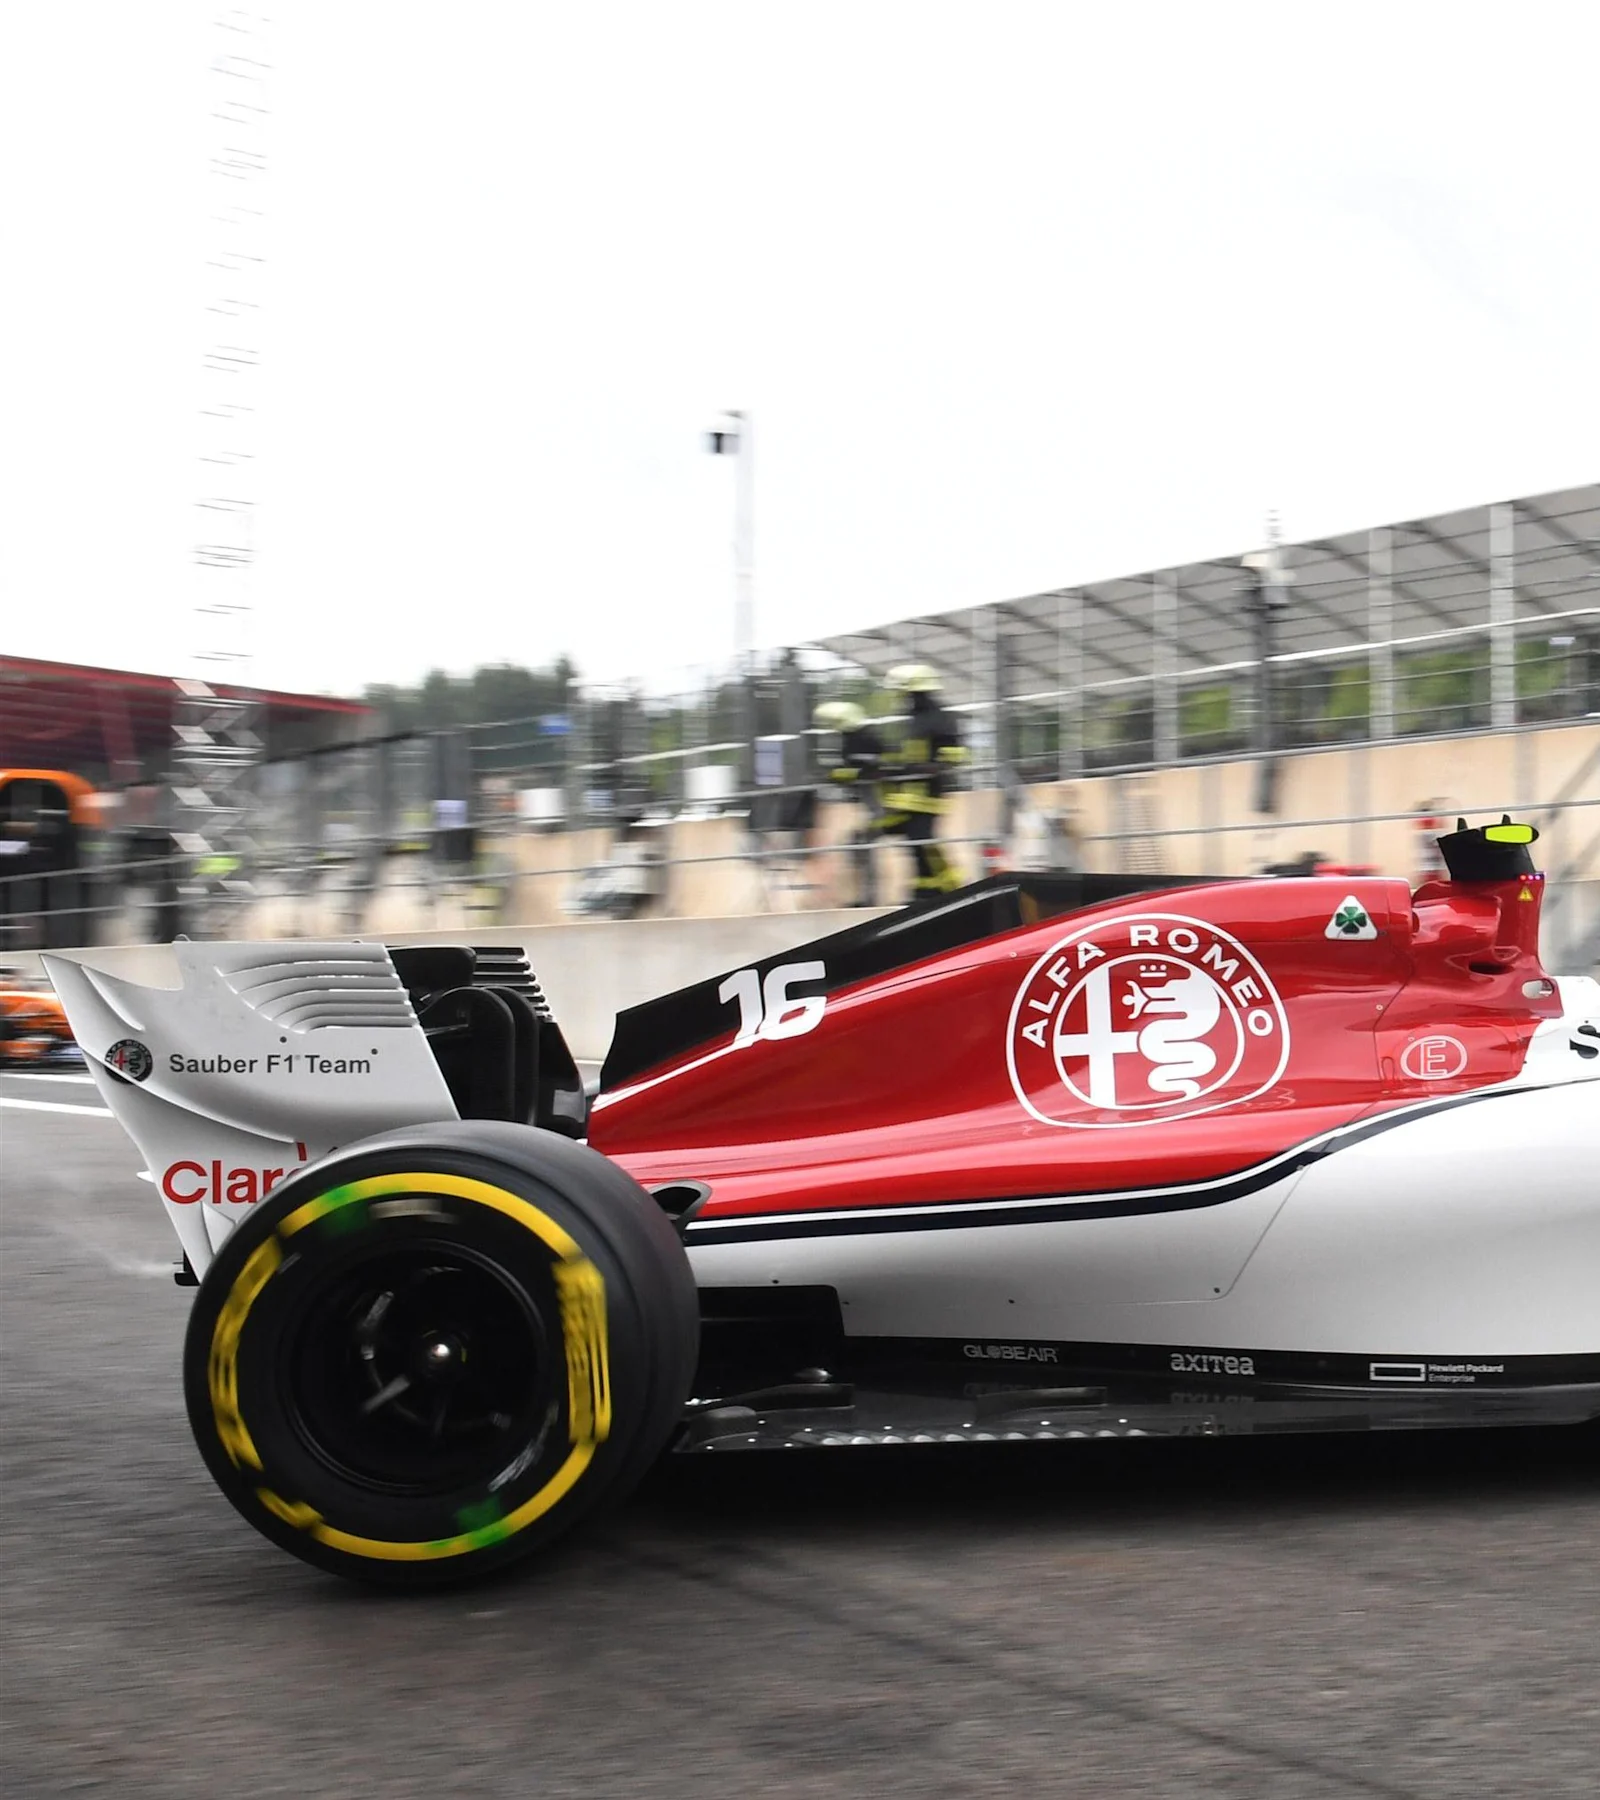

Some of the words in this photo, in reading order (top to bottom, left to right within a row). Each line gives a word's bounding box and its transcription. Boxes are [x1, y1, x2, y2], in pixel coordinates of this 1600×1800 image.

[1021, 940, 1107, 1048] ALFA
[1129, 924, 1274, 1037] ROMEO
[718, 960, 828, 1047] 16
[169, 1053, 258, 1074] Sauber
[266, 1054, 294, 1073] F1
[305, 1054, 371, 1074] Team
[162, 1159, 302, 1205] Clar
[963, 1344, 1058, 1363] GLOBEAIR
[1466, 1363, 1504, 1373] Packard
